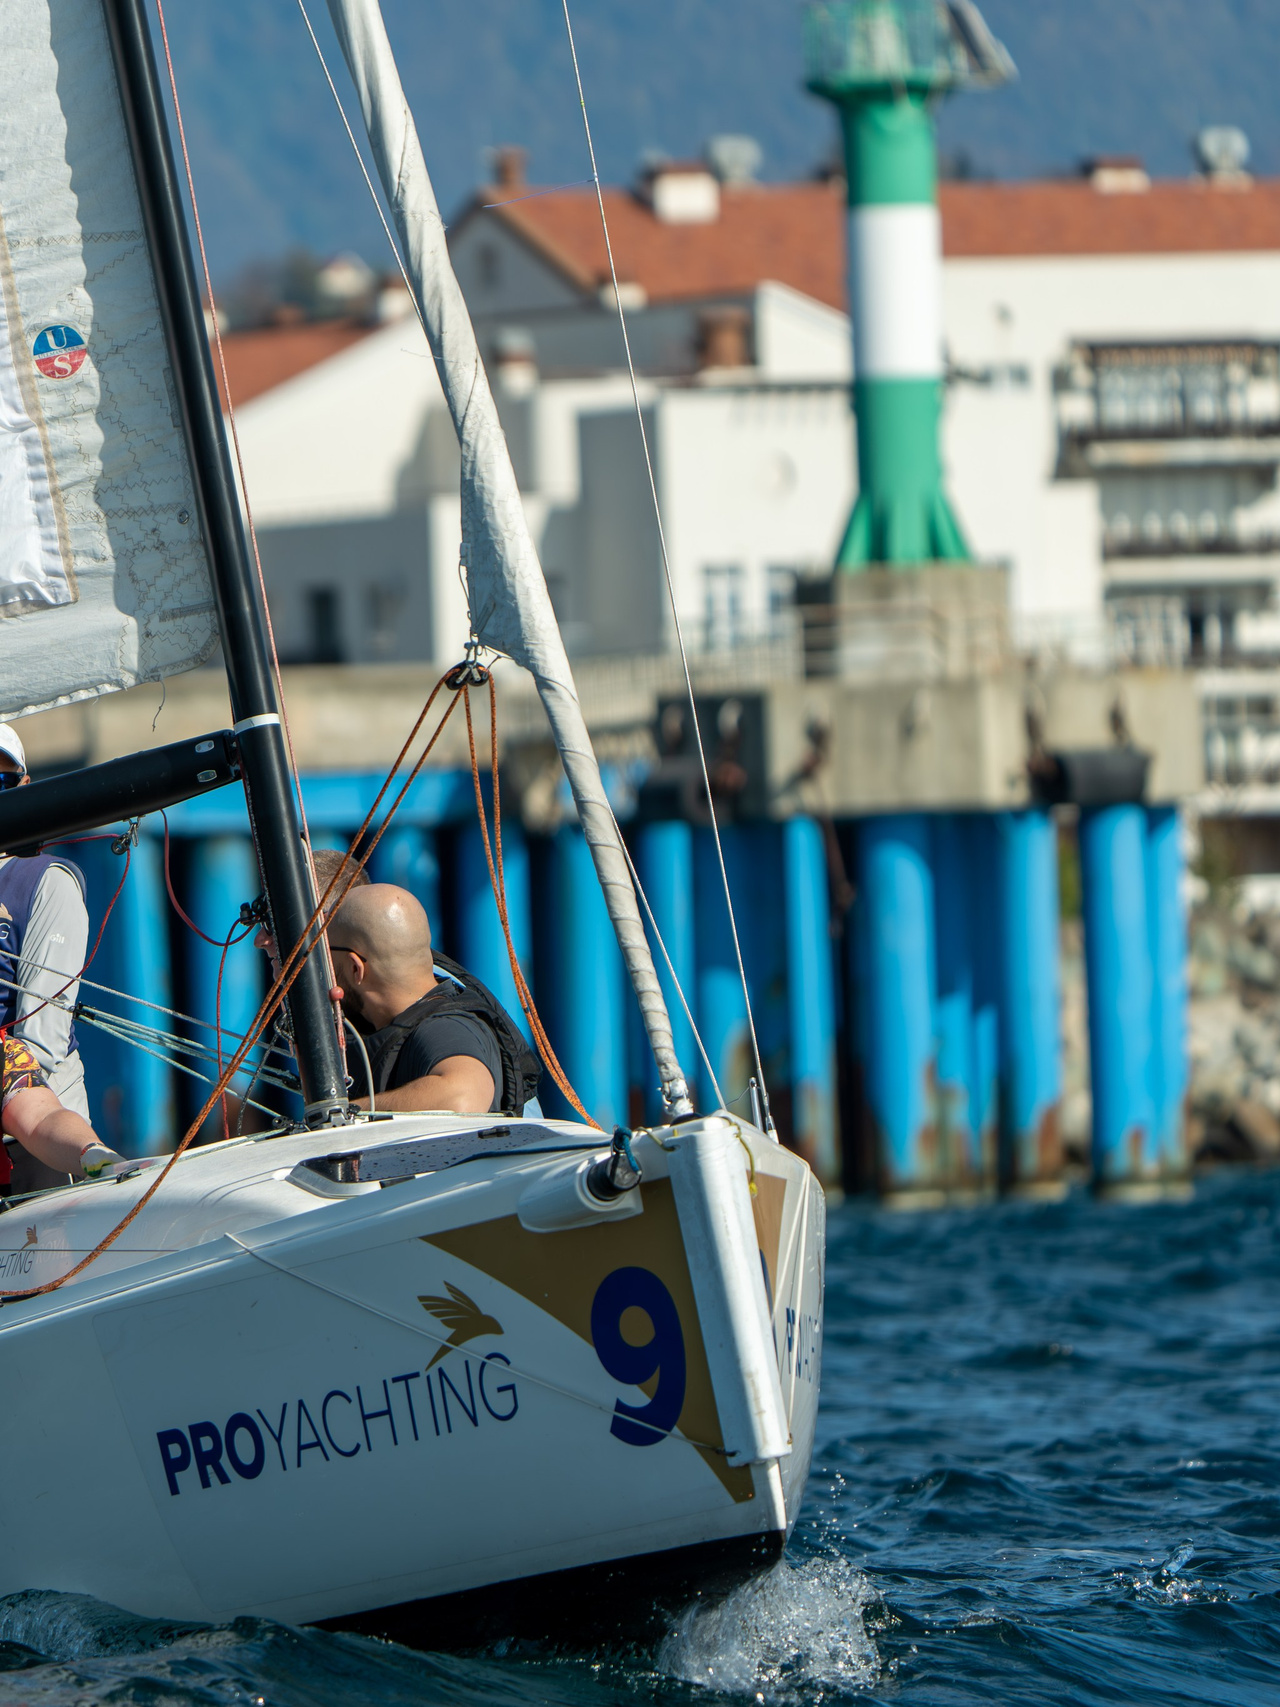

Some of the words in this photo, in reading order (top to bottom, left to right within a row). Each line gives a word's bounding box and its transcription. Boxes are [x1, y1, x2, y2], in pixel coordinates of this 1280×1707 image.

[44, 326, 67, 350] U
[53, 354, 73, 378] S
[50, 932, 65, 944] Gill
[590, 1265, 687, 1447] 9
[156, 1351, 519, 1496] PROYACHTING
